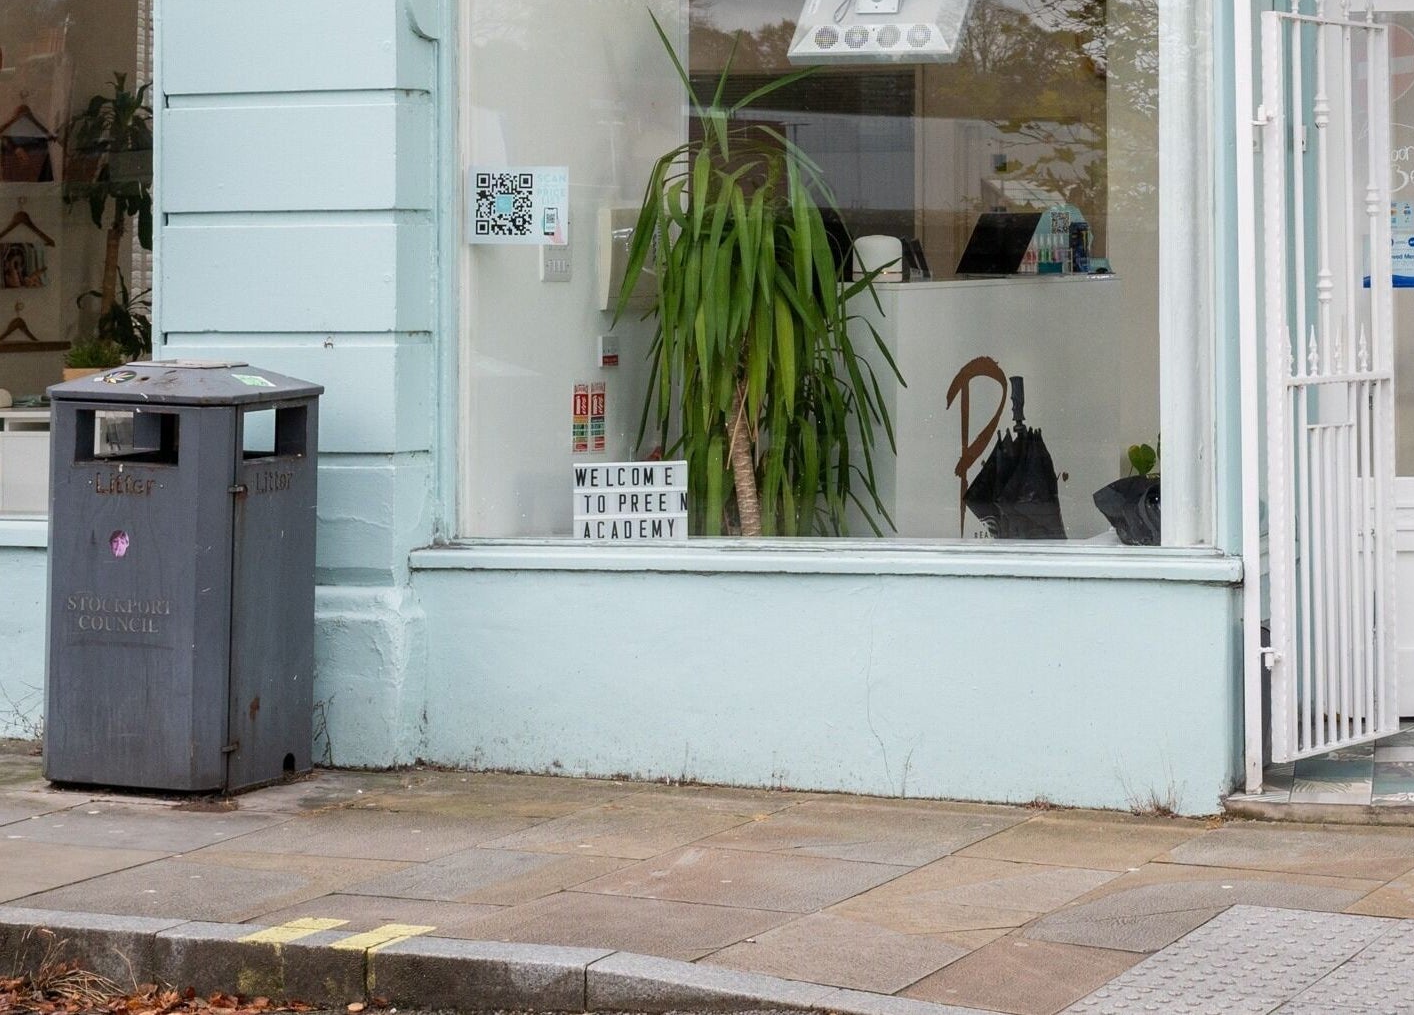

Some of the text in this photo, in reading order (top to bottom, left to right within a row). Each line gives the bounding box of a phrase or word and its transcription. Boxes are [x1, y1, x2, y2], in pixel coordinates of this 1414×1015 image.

[95, 472, 156, 496] Litter
[255, 471, 294, 493] Litter
[575, 466, 674, 487] WELCOME
[584, 492, 688, 514] TO PREEN
[583, 518, 675, 540] ACADEMY
[67, 594, 171, 616] STOCKPORT
[78, 615, 160, 634] COUNCIL
